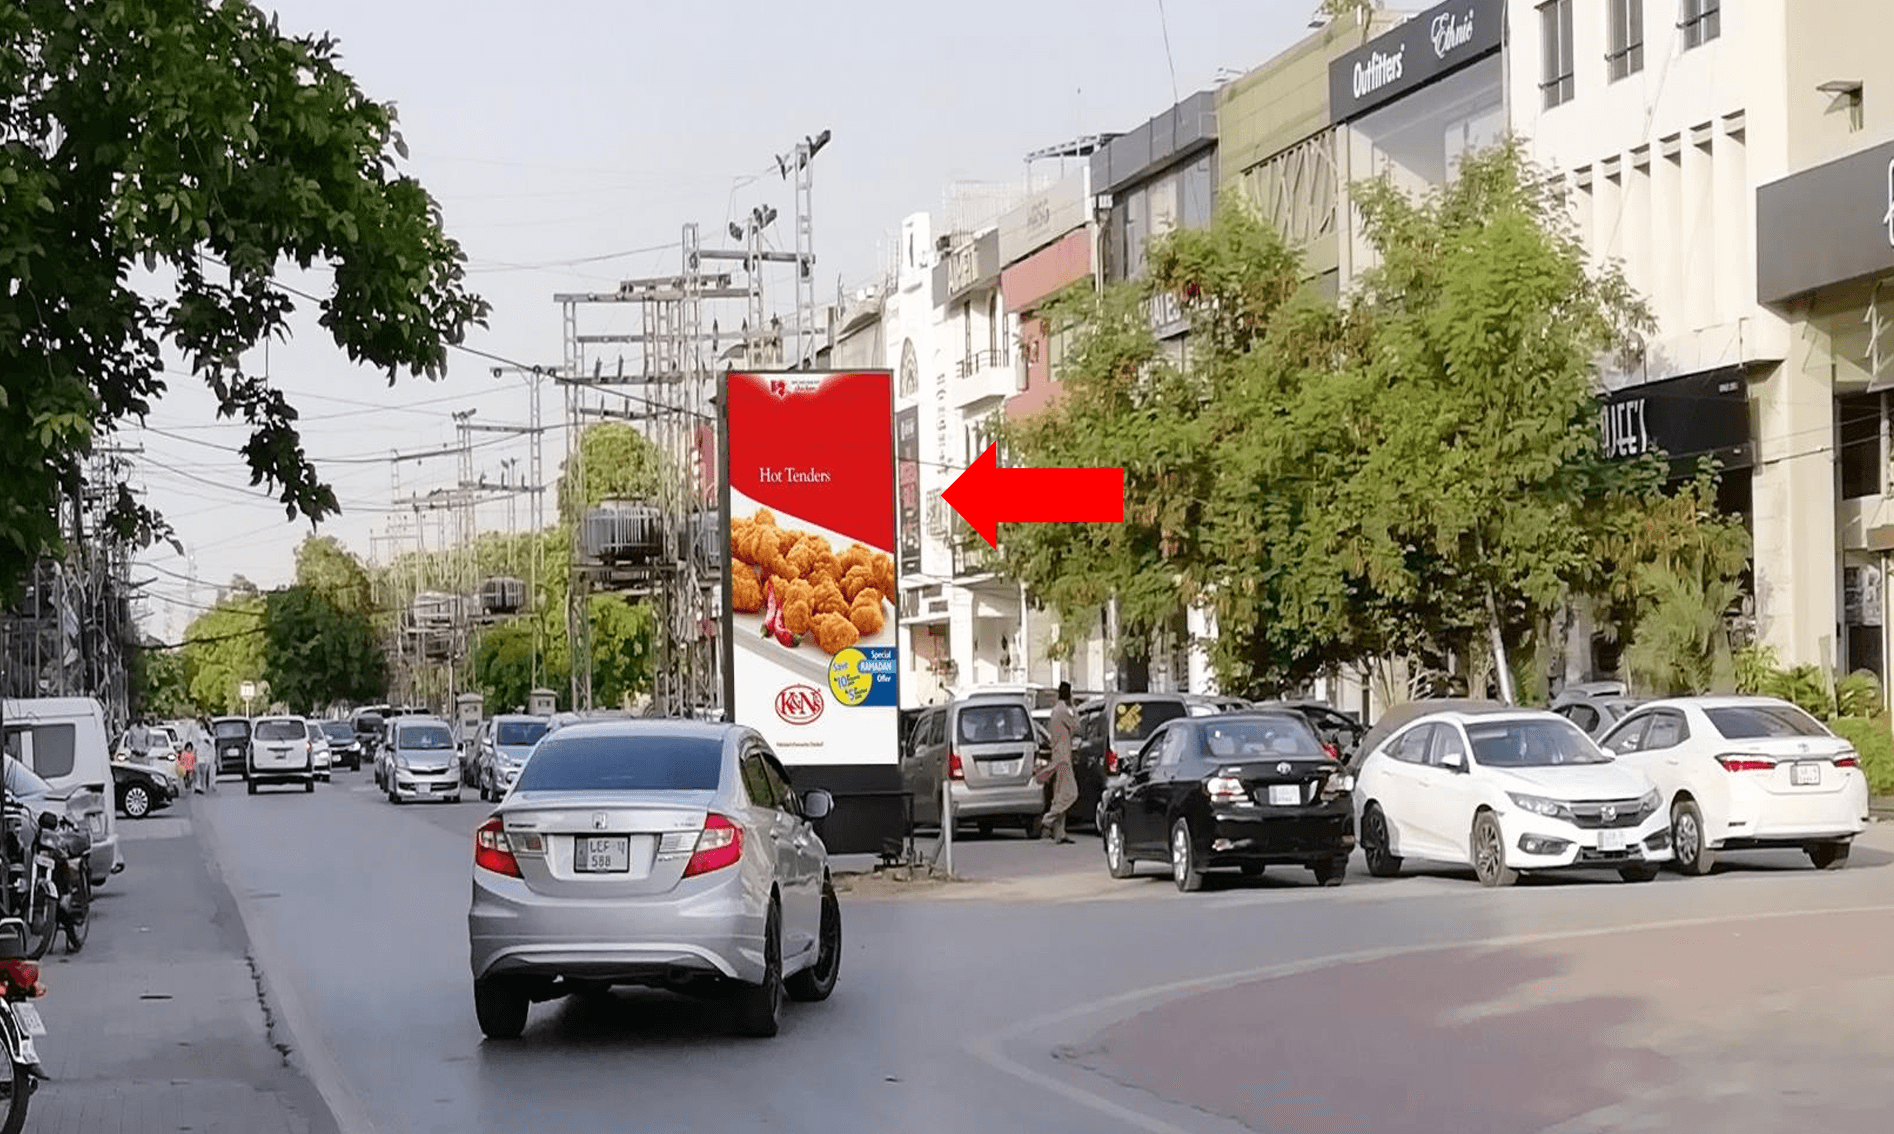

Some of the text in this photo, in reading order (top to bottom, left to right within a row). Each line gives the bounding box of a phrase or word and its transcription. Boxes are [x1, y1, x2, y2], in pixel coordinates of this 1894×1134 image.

[1430, 11, 1474, 59] Ethnic
[1353, 50, 1404, 99] Outfitters
[759, 467, 832, 484] Hot Tenders
[871, 649, 891, 659] Special
[860, 661, 892, 671] RAMADAN
[877, 674, 891, 682] Offer
